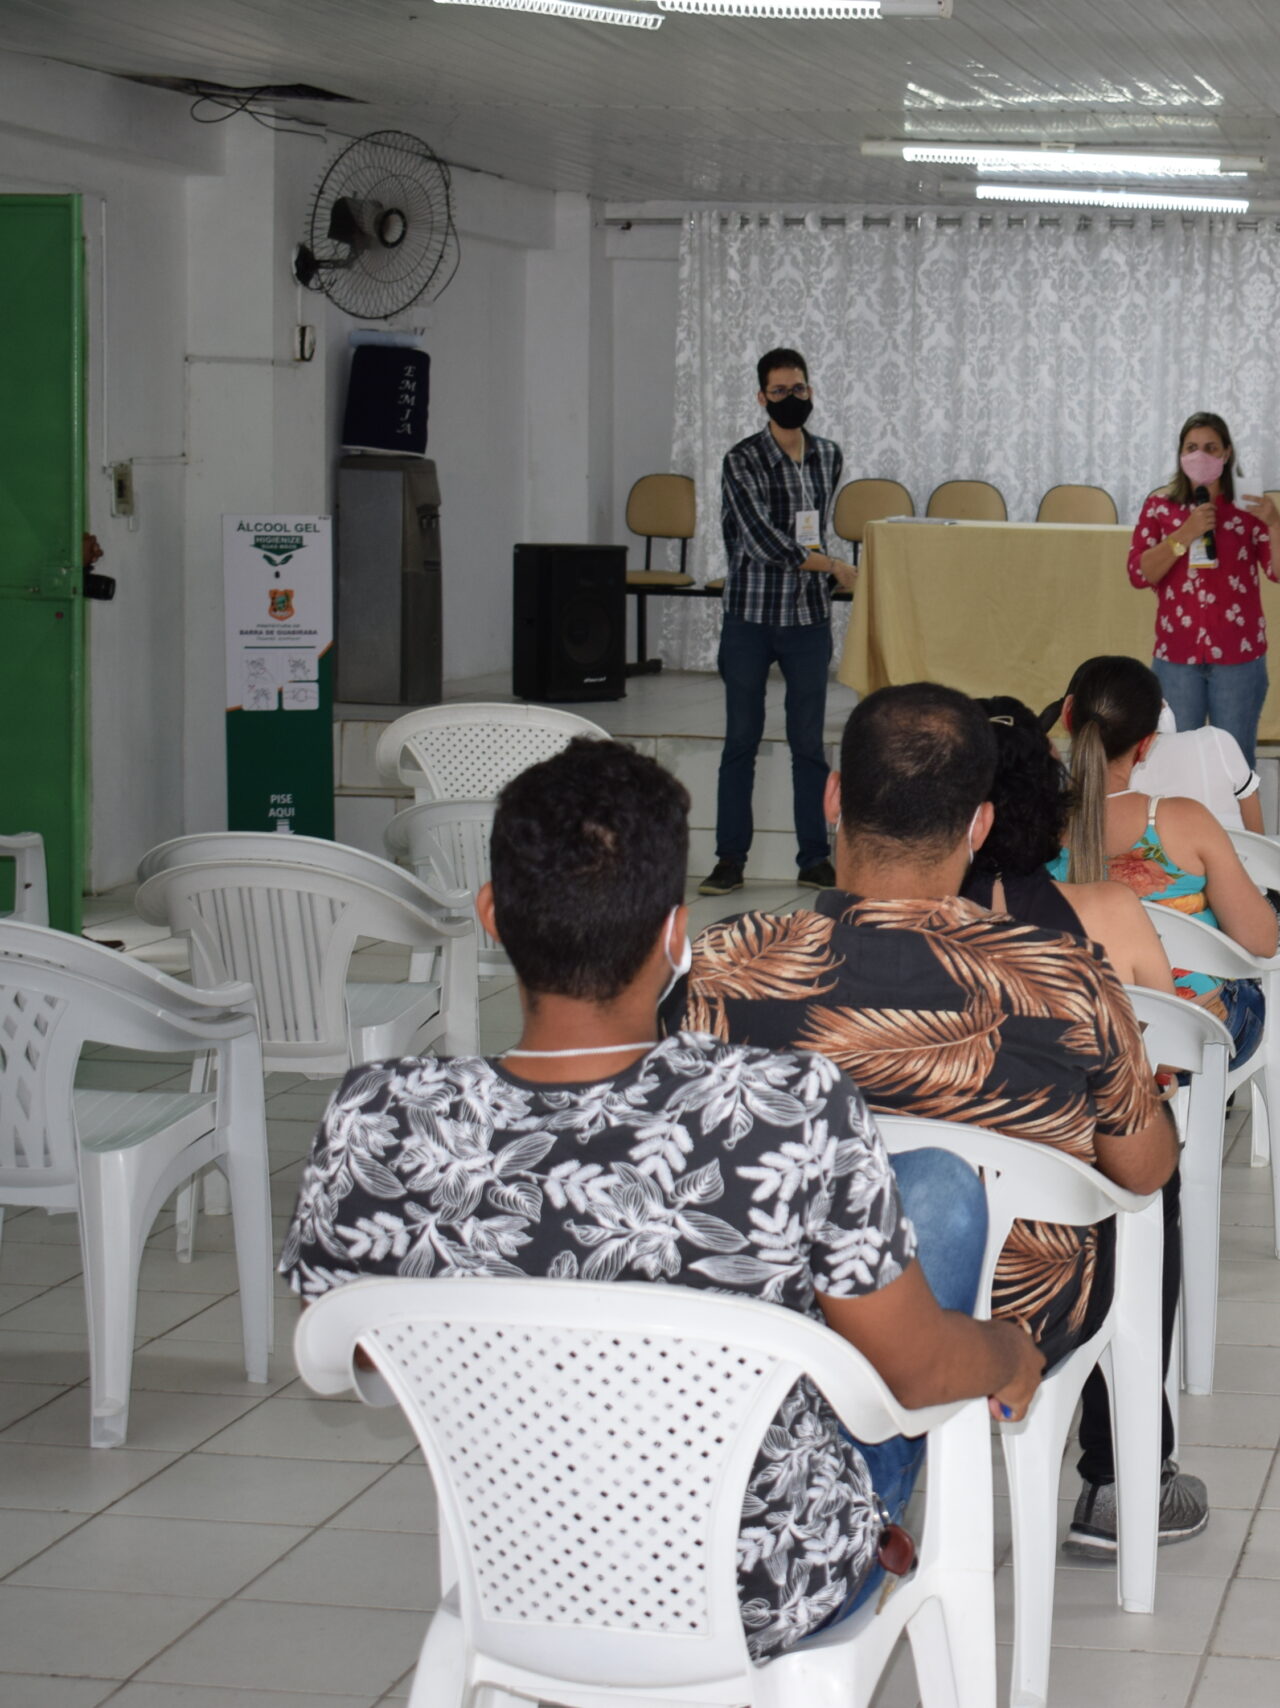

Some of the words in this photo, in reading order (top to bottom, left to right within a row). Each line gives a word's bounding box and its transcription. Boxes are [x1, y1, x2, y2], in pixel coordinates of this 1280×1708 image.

[237, 520, 291, 533] ÁLCOOL
[295, 523, 320, 533] GEL
[256, 536, 300, 544] HIGIENIZE
[270, 793, 293, 804] PISE
[268, 807, 295, 818] AQUI
